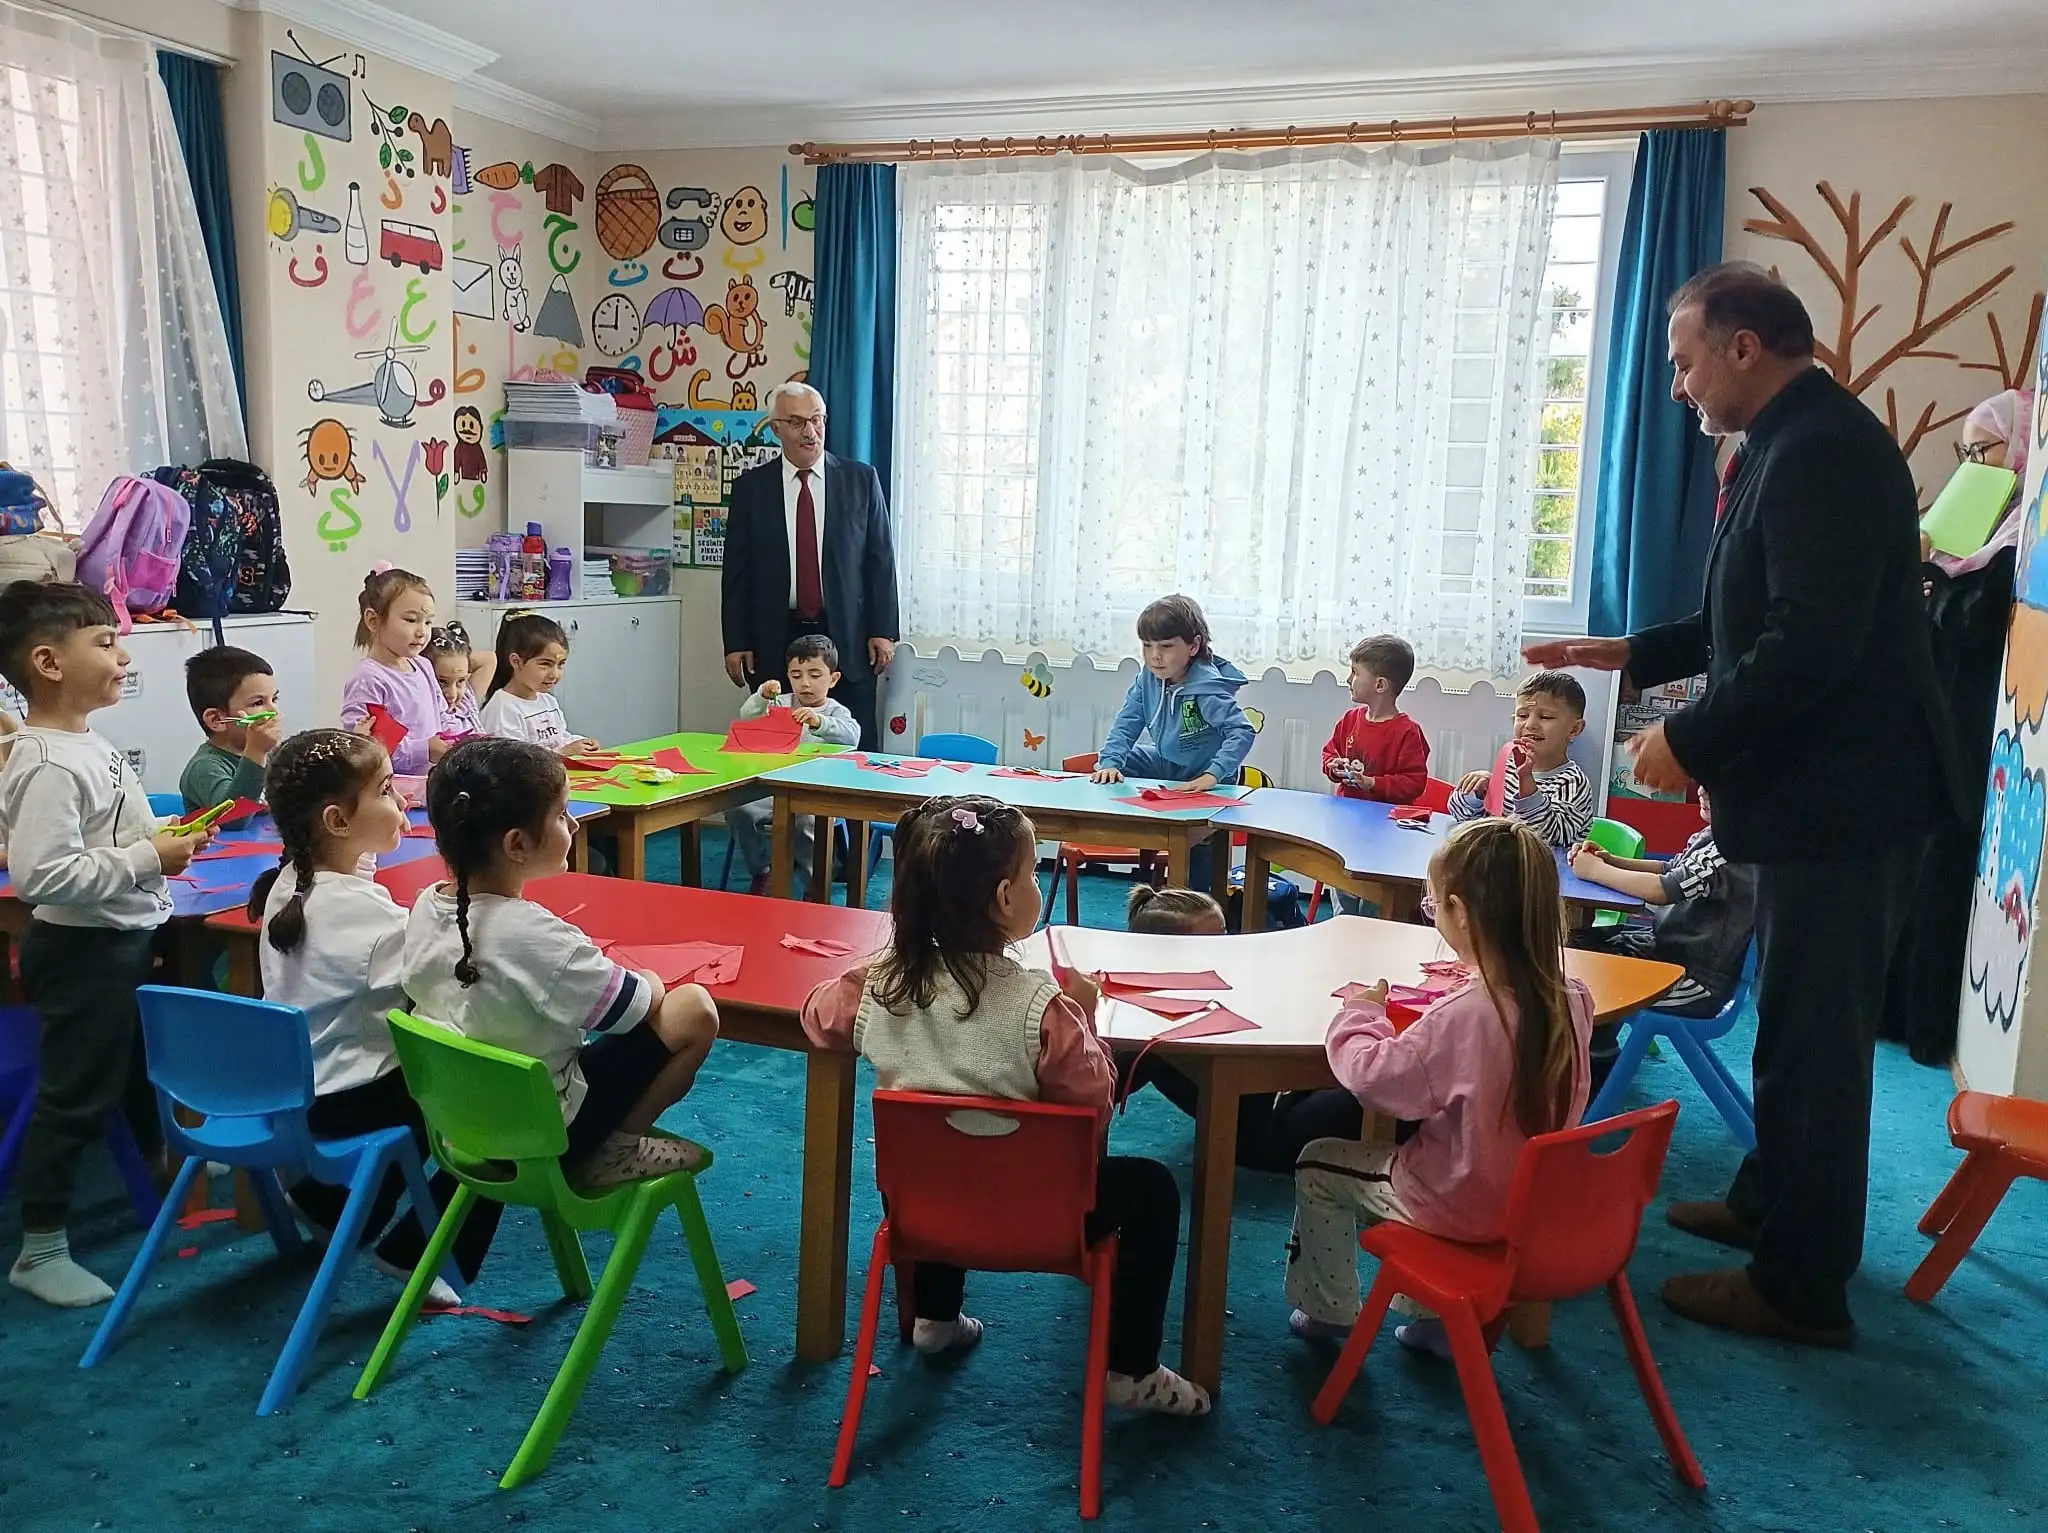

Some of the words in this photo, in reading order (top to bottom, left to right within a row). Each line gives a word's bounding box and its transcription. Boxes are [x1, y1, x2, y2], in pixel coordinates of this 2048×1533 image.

[543, 213, 582, 275] ج
[662, 251, 704, 281] ت
[400, 278, 437, 344] ع
[648, 329, 697, 382] ش
[725, 350, 768, 380] س
